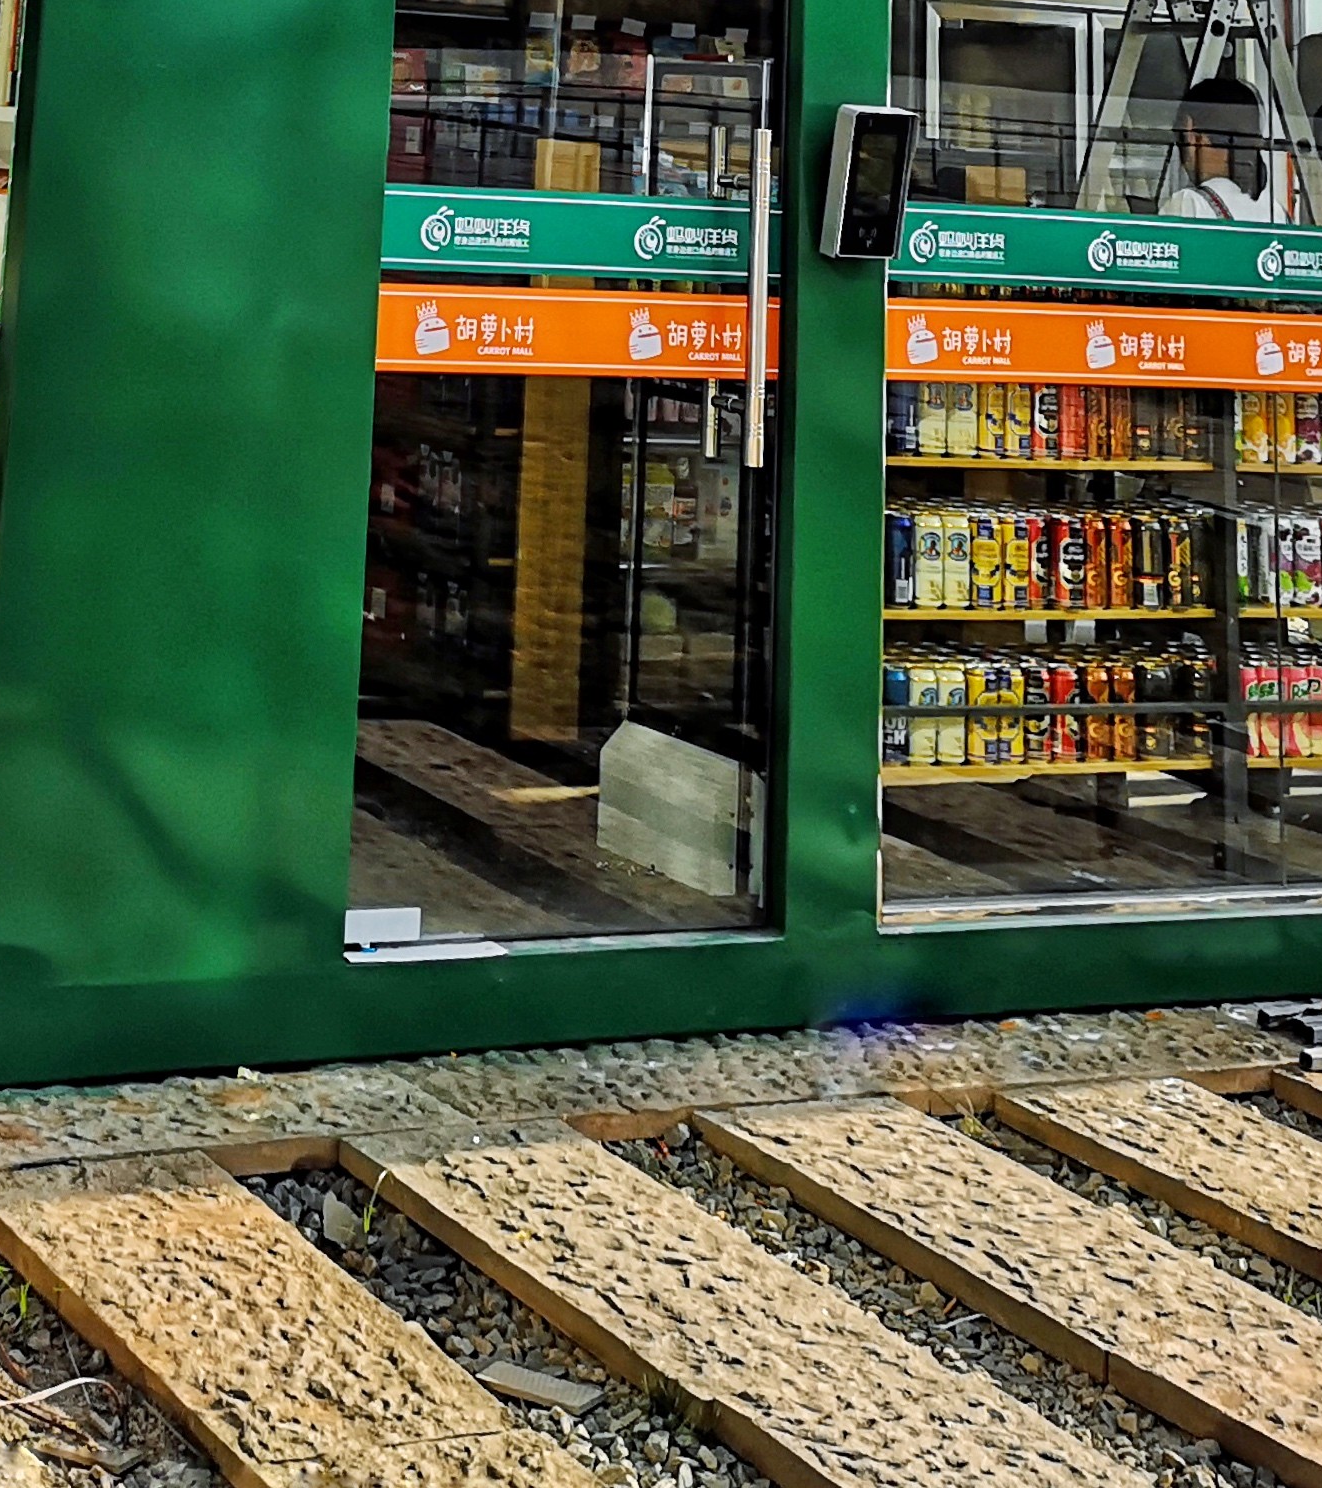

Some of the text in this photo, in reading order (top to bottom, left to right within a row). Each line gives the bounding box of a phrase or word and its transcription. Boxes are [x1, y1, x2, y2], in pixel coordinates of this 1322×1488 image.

[455, 313, 534, 345] 胡萝卜村
[667, 320, 742, 351] 胡萝卜村
[942, 325, 1012, 355] 胡萝卜村
[477, 346, 510, 356] CARROT
[1119, 331, 1185, 360] 胡萝卜村
